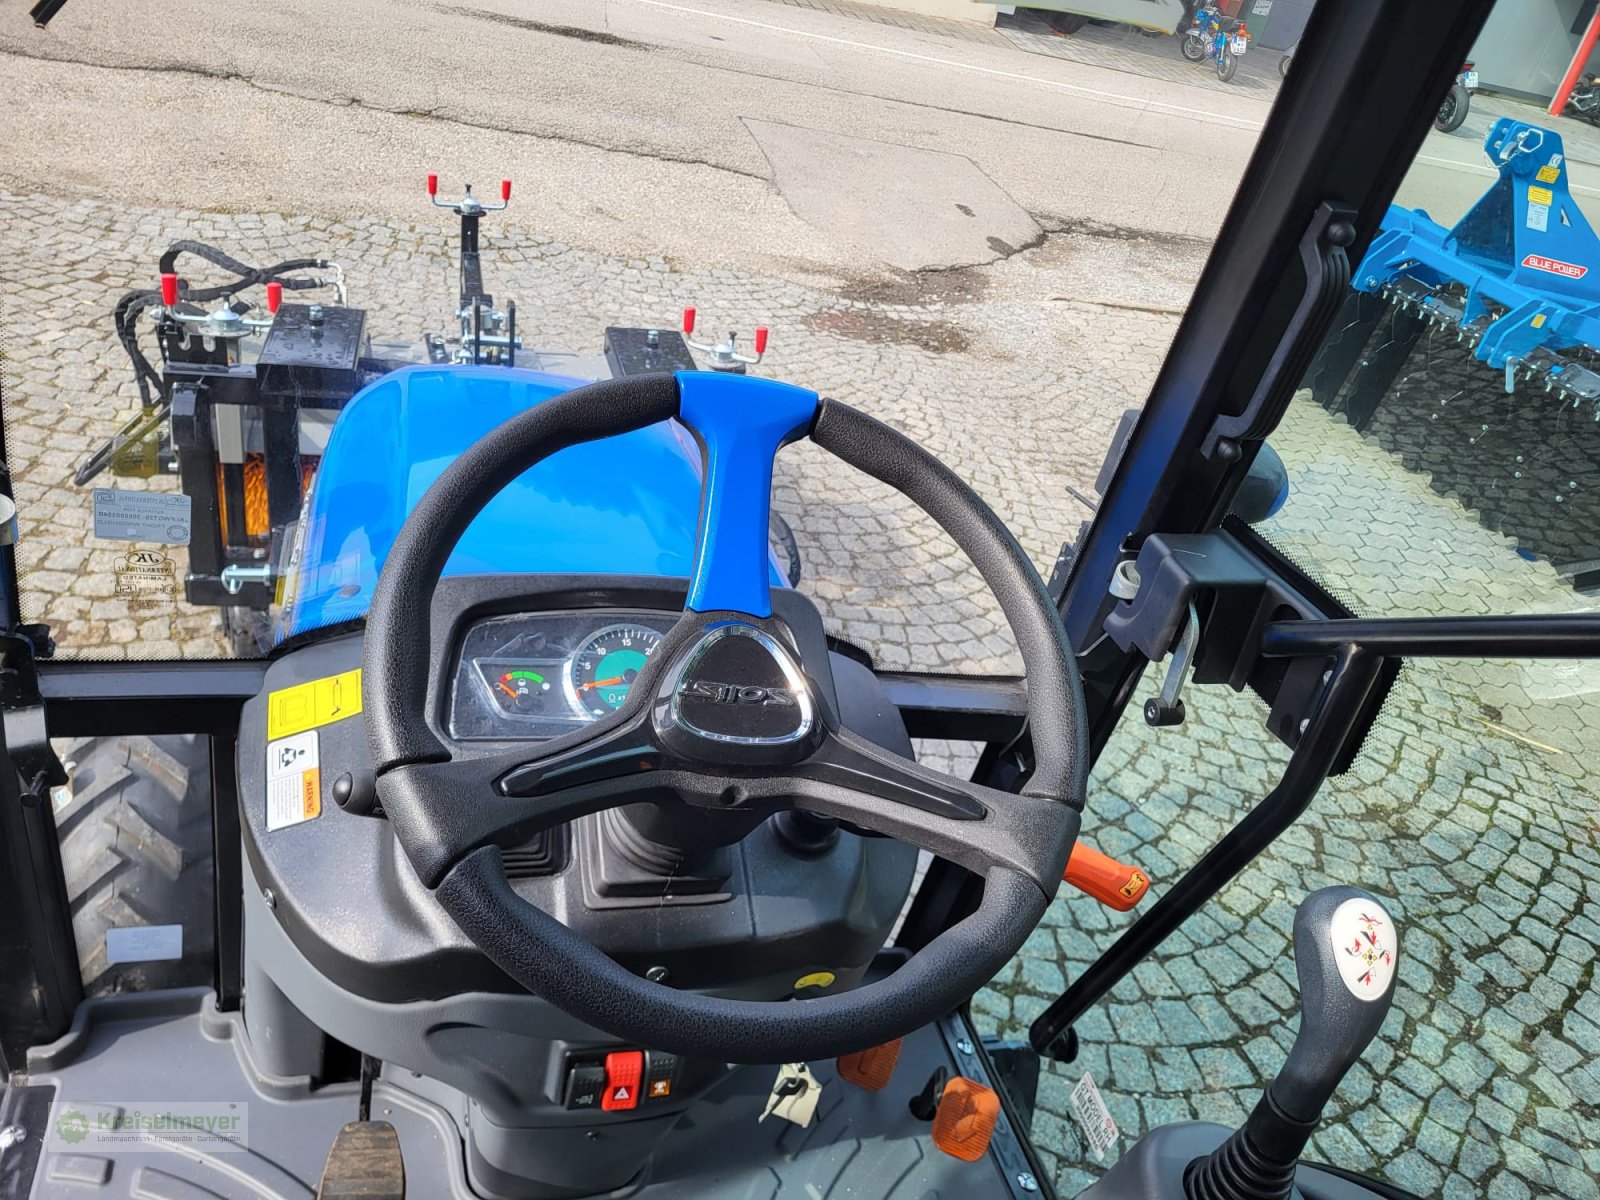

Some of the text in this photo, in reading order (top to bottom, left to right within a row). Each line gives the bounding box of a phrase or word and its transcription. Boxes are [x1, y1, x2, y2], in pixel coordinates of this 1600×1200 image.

[1529, 257, 1581, 276] BLUE POWER
[622, 638, 632, 647] 15
[597, 647, 606, 655] 10
[585, 662, 591, 670] 5
[306, 781, 314, 814] WARNING
